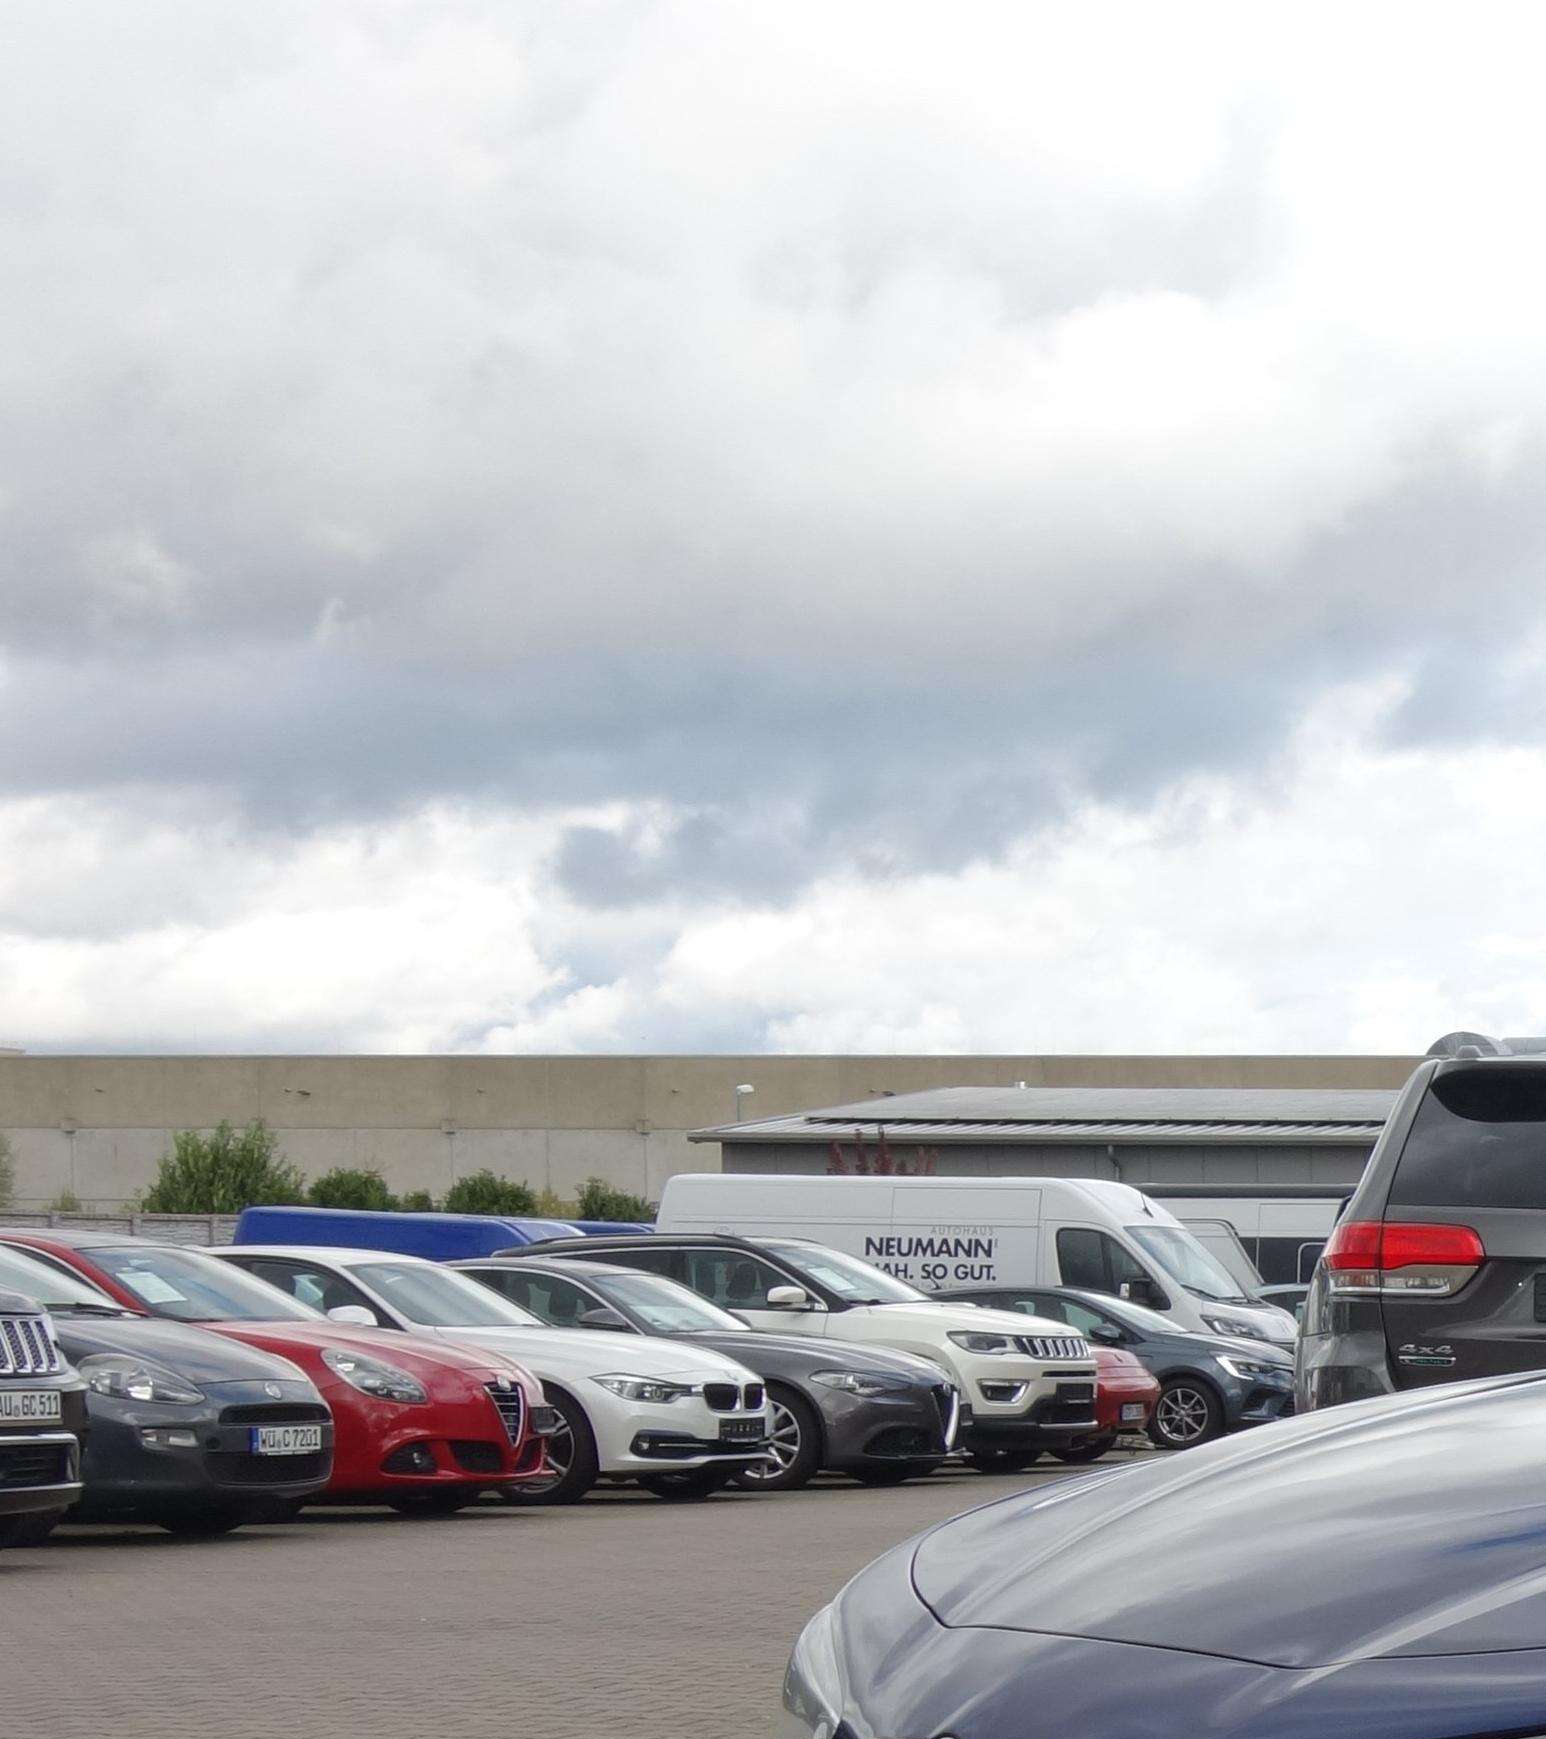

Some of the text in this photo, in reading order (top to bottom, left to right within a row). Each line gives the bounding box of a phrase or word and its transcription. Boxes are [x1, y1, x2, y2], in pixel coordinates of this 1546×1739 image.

[929, 1225, 995, 1236] AUTOHAUS
[864, 1236, 993, 1258] NEUMANN
[920, 1262, 948, 1280] SO
[953, 1263, 997, 1281] GUT.
[39, 1394, 59, 1415] 511
[283, 1429, 291, 1448] C
